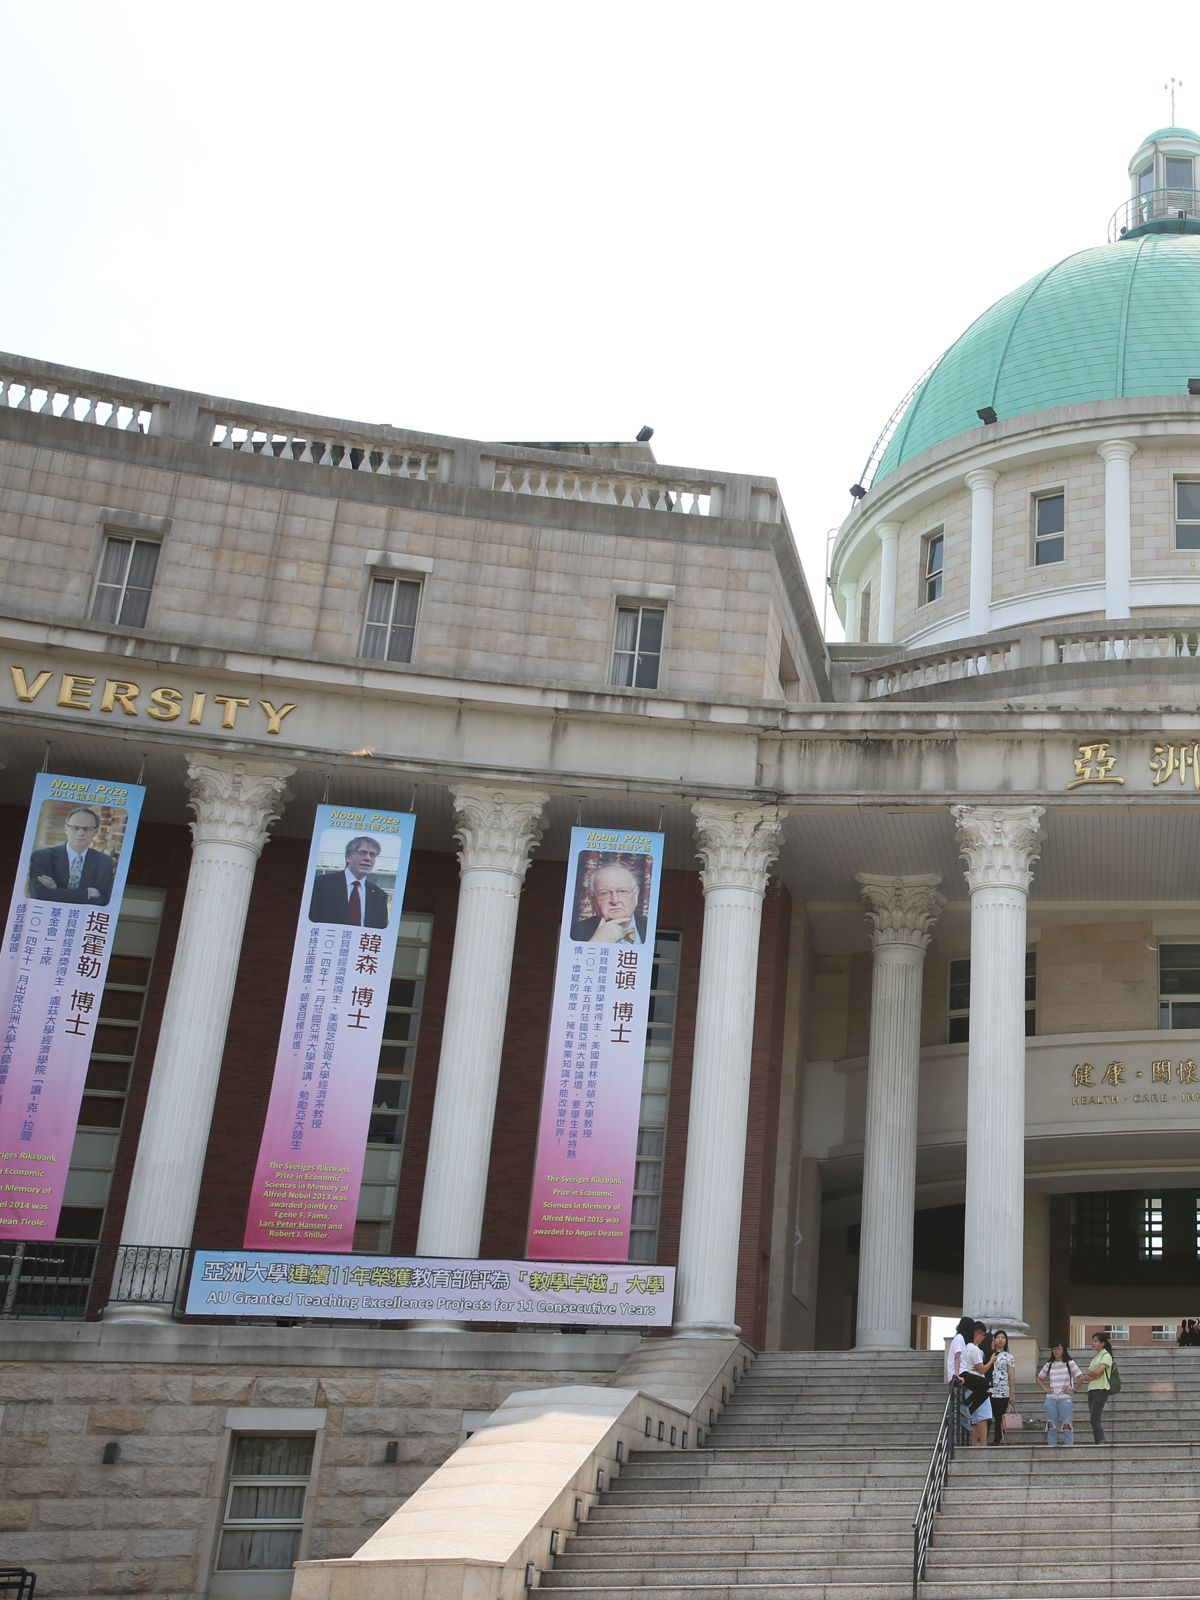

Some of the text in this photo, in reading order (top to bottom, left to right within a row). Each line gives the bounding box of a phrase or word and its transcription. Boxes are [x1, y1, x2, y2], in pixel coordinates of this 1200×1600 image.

[9, 665, 298, 735] VERSITY
[48, 789, 75, 799] 2014
[51, 779, 128, 797] Nobel Prize
[331, 810, 401, 825] Nobel Prize
[586, 832, 652, 844] Nobel Prize
[40, 907, 62, 966] 基金會」主席
[65, 910, 110, 1036] 提霍勒 博士
[347, 932, 383, 1030] 韓森 博士
[610, 949, 639, 1044] 迪頓 博士
[1072, 1095, 1119, 1106] HEALTH
[1132, 1093, 1168, 1104] CARE
[4, 1168, 45, 1177] Economic
[304, 1174, 341, 1182] Economic
[5, 1185, 41, 1194] Memory
[265, 1181, 338, 1192] Sciences Memory
[263, 1190, 287, 1198] Alfred
[9, 1201, 30, 1209] 2014
[269, 1201, 302, 1209] awarded
[298, 1221, 327, 1229] Hansen
[269, 1230, 295, 1238] Robert
[202, 1260, 664, 1295] 亞洲大學連續11年榮獲教育部評為「教學卓越」大學
[206, 1290, 656, 1316] AU Granted Teaching Excellence Projects for 11 Consecutive Years
